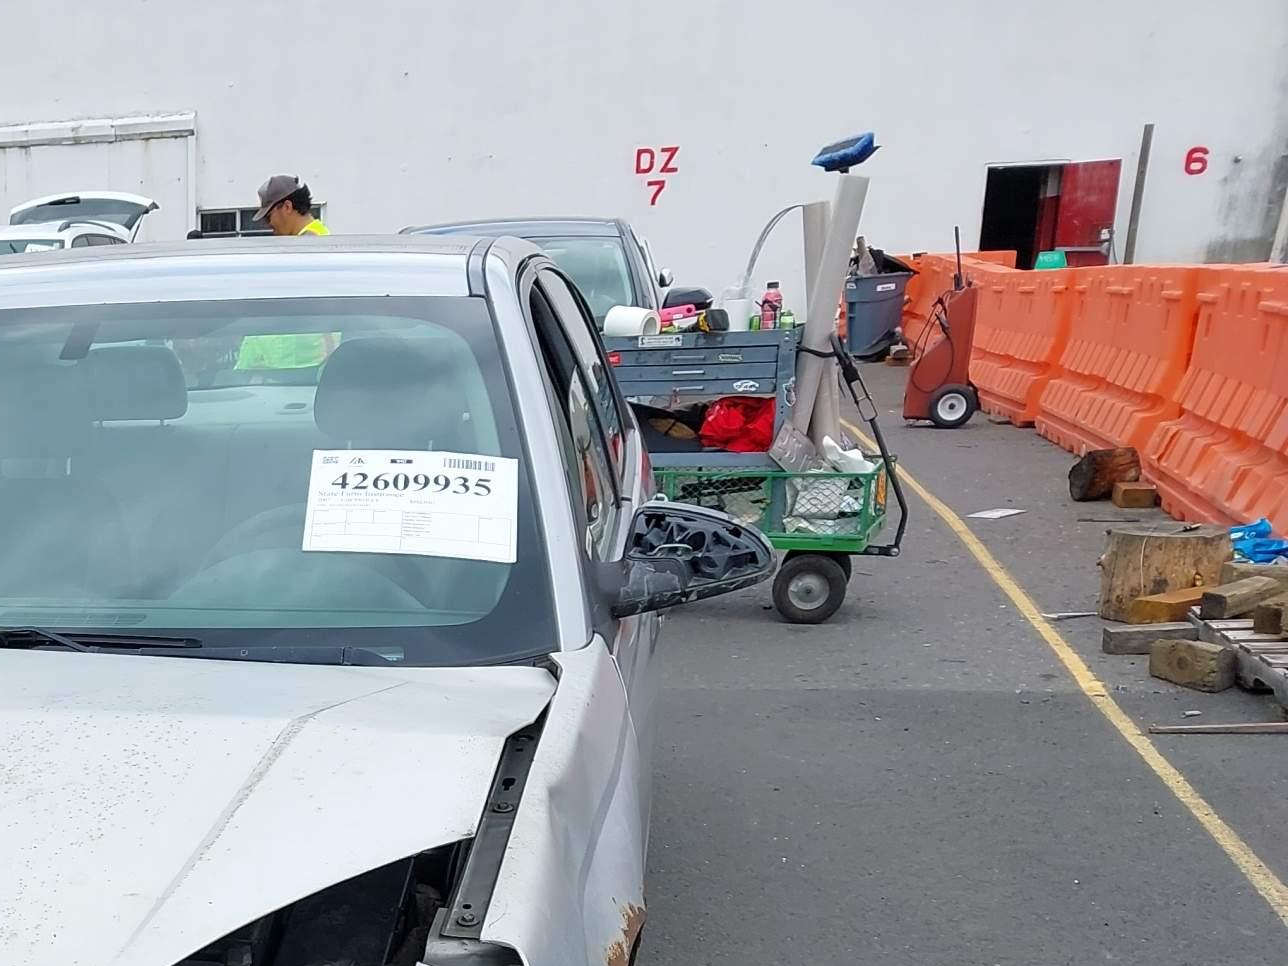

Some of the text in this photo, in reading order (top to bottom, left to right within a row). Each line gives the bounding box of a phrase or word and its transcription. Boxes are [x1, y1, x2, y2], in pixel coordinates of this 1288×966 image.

[635, 146, 680, 174] DZ
[1184, 147, 1209, 175] 6
[647, 180, 666, 206] 7
[331, 472, 492, 497] 42609935
